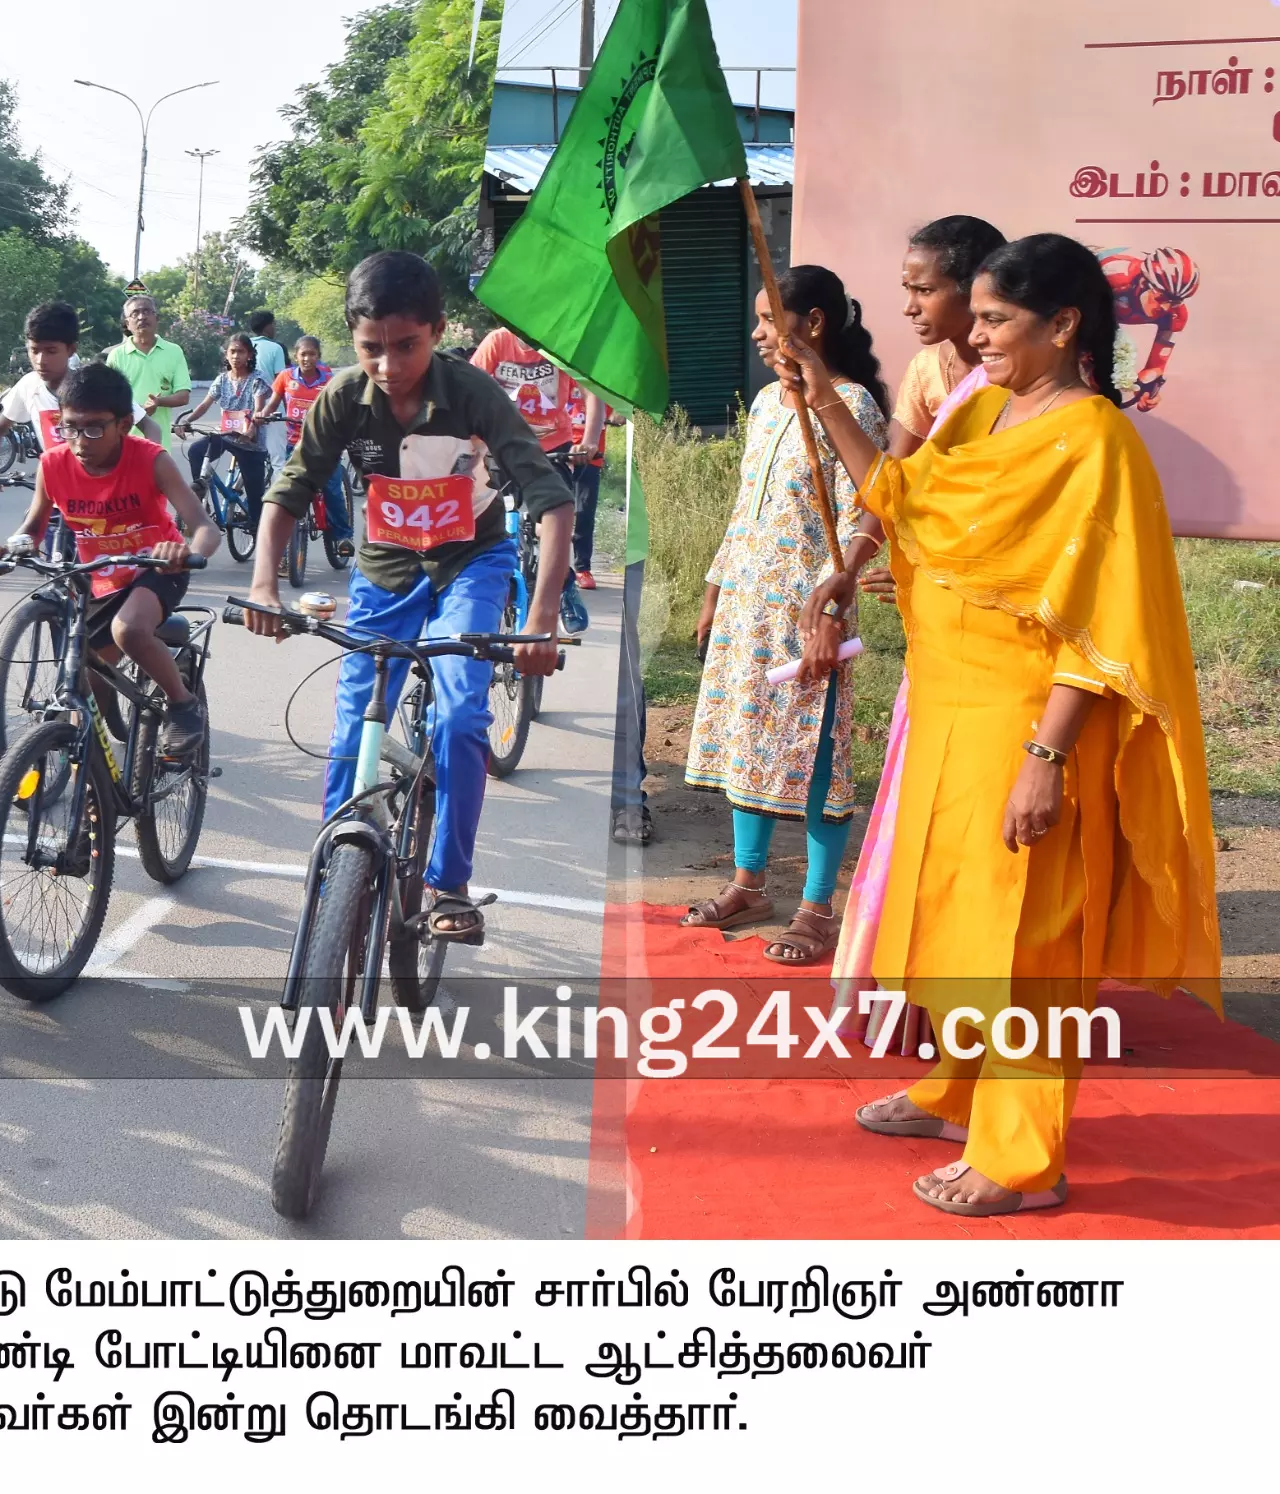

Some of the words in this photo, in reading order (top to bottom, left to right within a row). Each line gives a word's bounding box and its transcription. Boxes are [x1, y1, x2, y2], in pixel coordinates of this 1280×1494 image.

[1153, 56, 1253, 106] நாள்
[1069, 160, 1169, 198] இடம்
[500, 363, 554, 380] FEARLESS
[388, 482, 448, 501] SDAT
[67, 492, 141, 514] BROOKLYN
[381, 500, 459, 531] 942
[377, 526, 466, 547] PERAMBALUR
